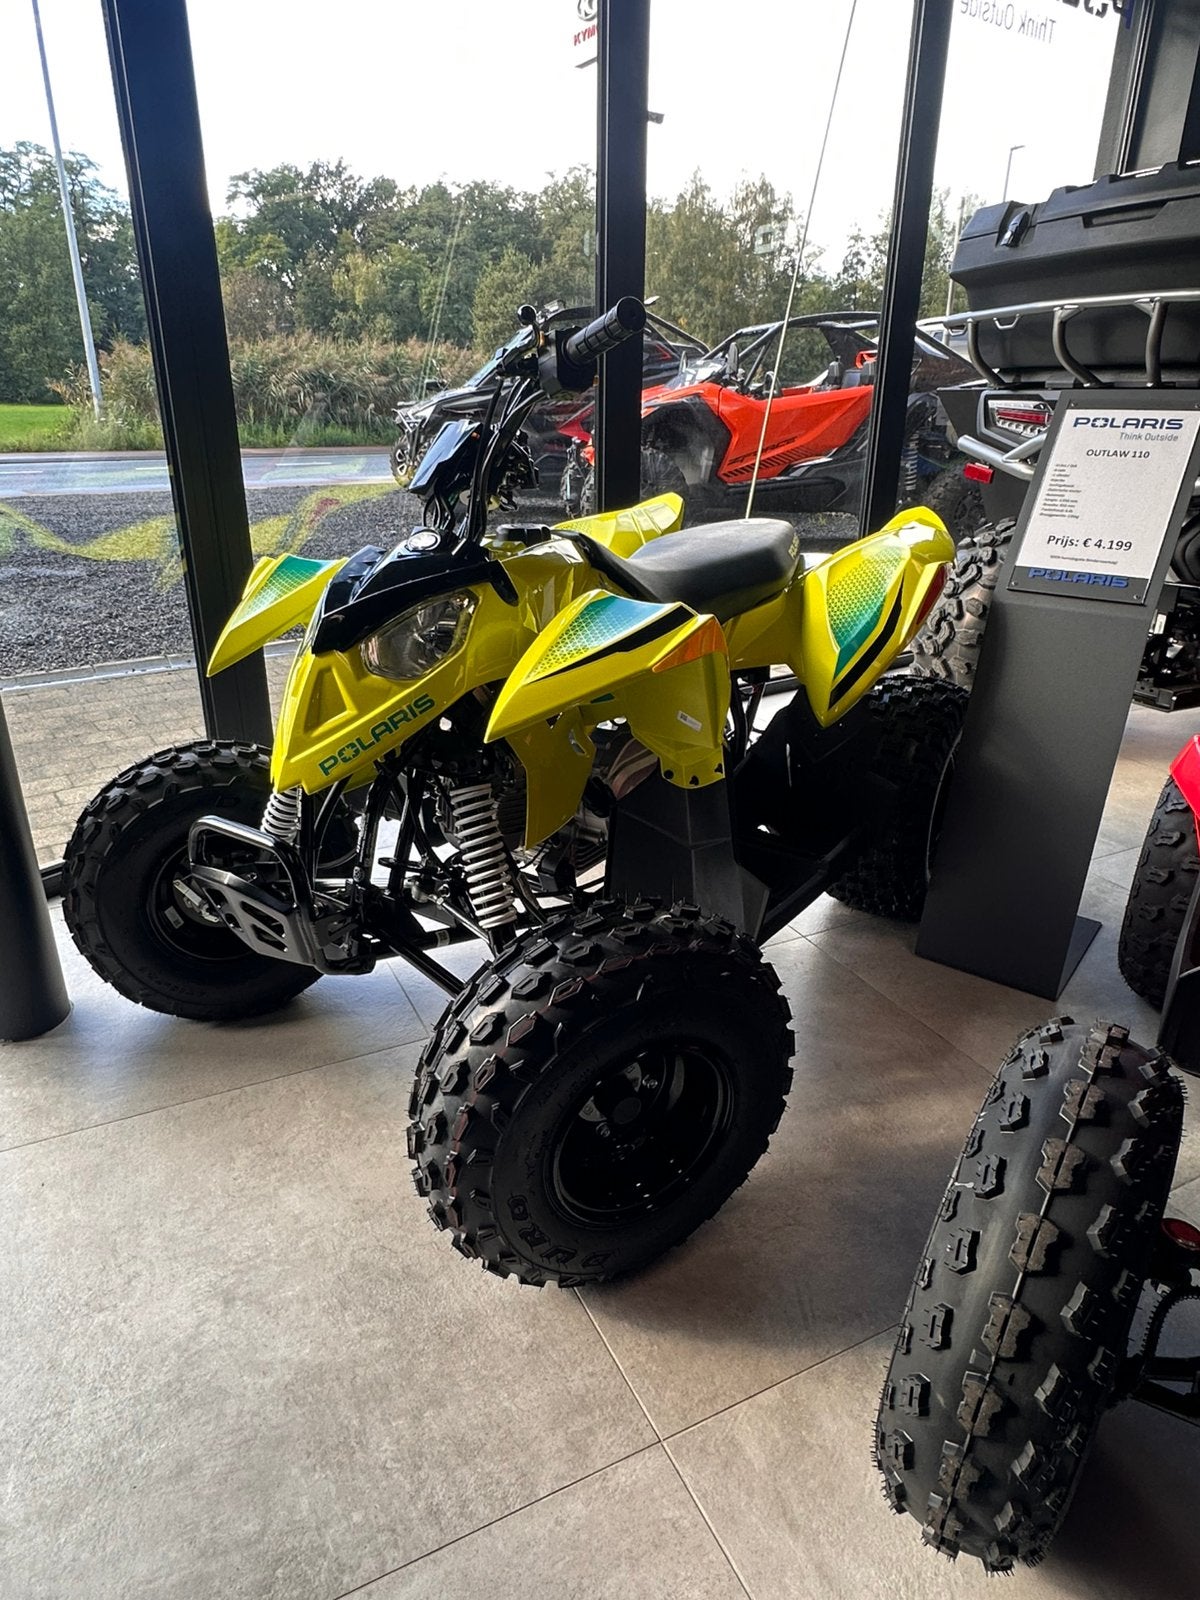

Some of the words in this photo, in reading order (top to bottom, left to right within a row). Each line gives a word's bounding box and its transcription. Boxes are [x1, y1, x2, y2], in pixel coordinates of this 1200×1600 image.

[1073, 417, 1184, 430] POLARIS
[1119, 432, 1143, 441] Think
[1144, 432, 1179, 442] Outside
[1086, 449, 1130, 458] OUTLAW
[1132, 451, 1150, 459] 110
[1047, 535, 1079, 548] Prijs:
[1083, 538, 1092, 548] €
[1094, 539, 1132, 551] 4.199
[1028, 567, 1129, 588] POLARIS
[318, 693, 436, 777] POLARIS
